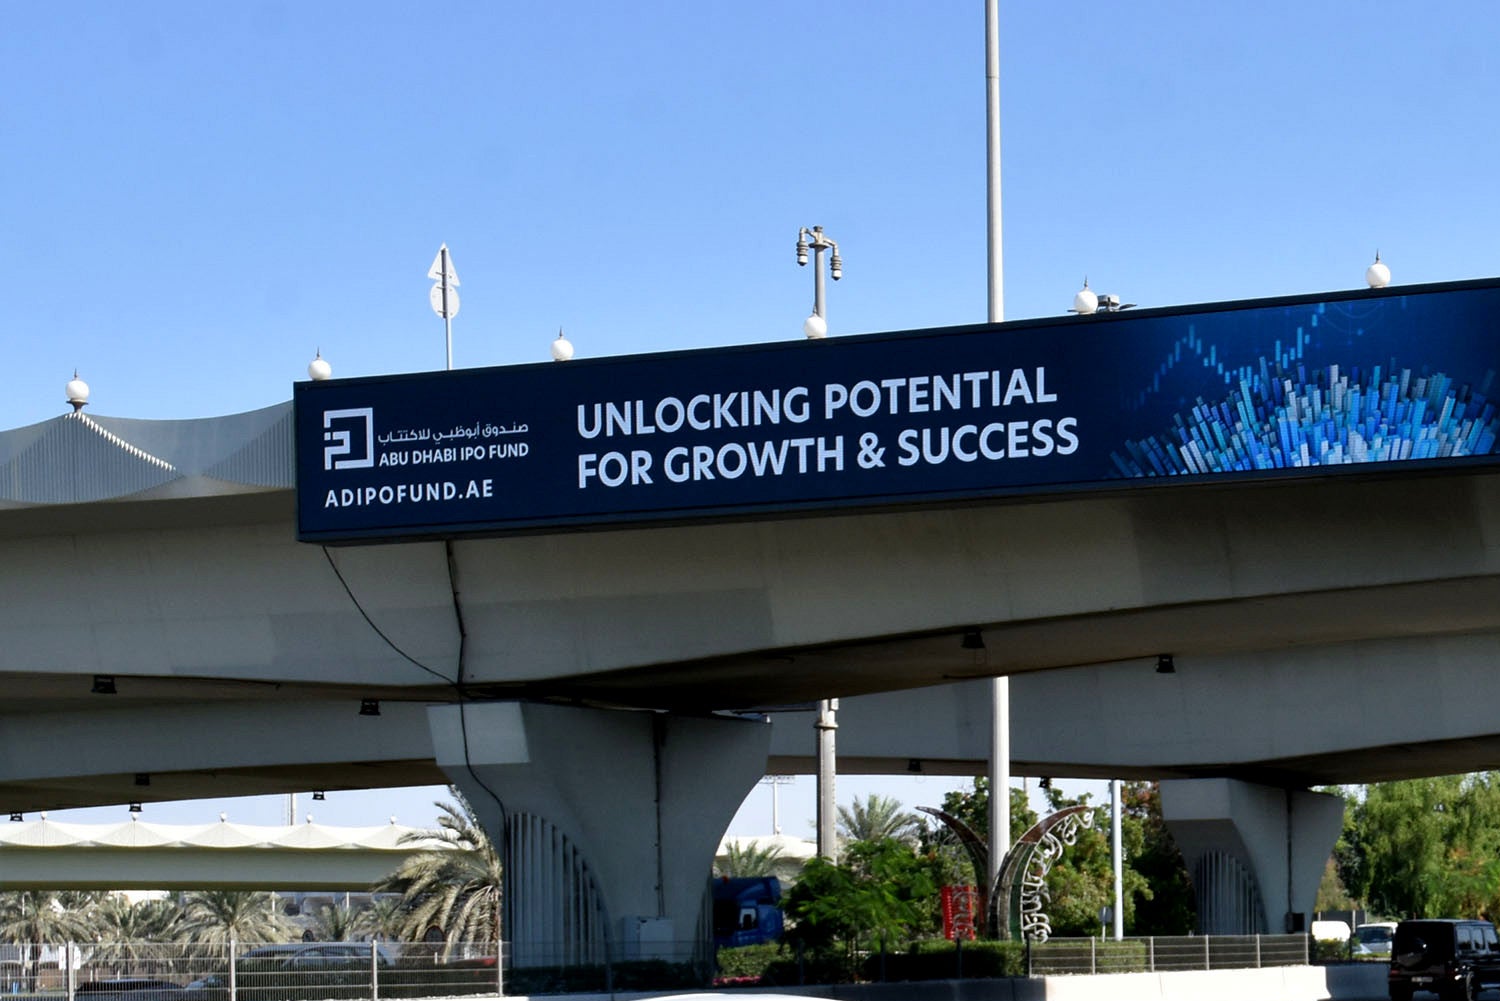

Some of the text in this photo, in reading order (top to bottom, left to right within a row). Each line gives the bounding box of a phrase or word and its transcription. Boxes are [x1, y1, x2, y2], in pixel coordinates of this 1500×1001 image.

[577, 367, 1058, 439] UNLOCKING POTENTIAL
[378, 421, 529, 445] صندوق أبوظبي للاكتتاب
[378, 442, 529, 467] ABU DHABI IPO FUND
[578, 417, 1079, 489] FOR GROWTH & SUCCESS
[324, 479, 493, 508] ADIPOFUND.AE
